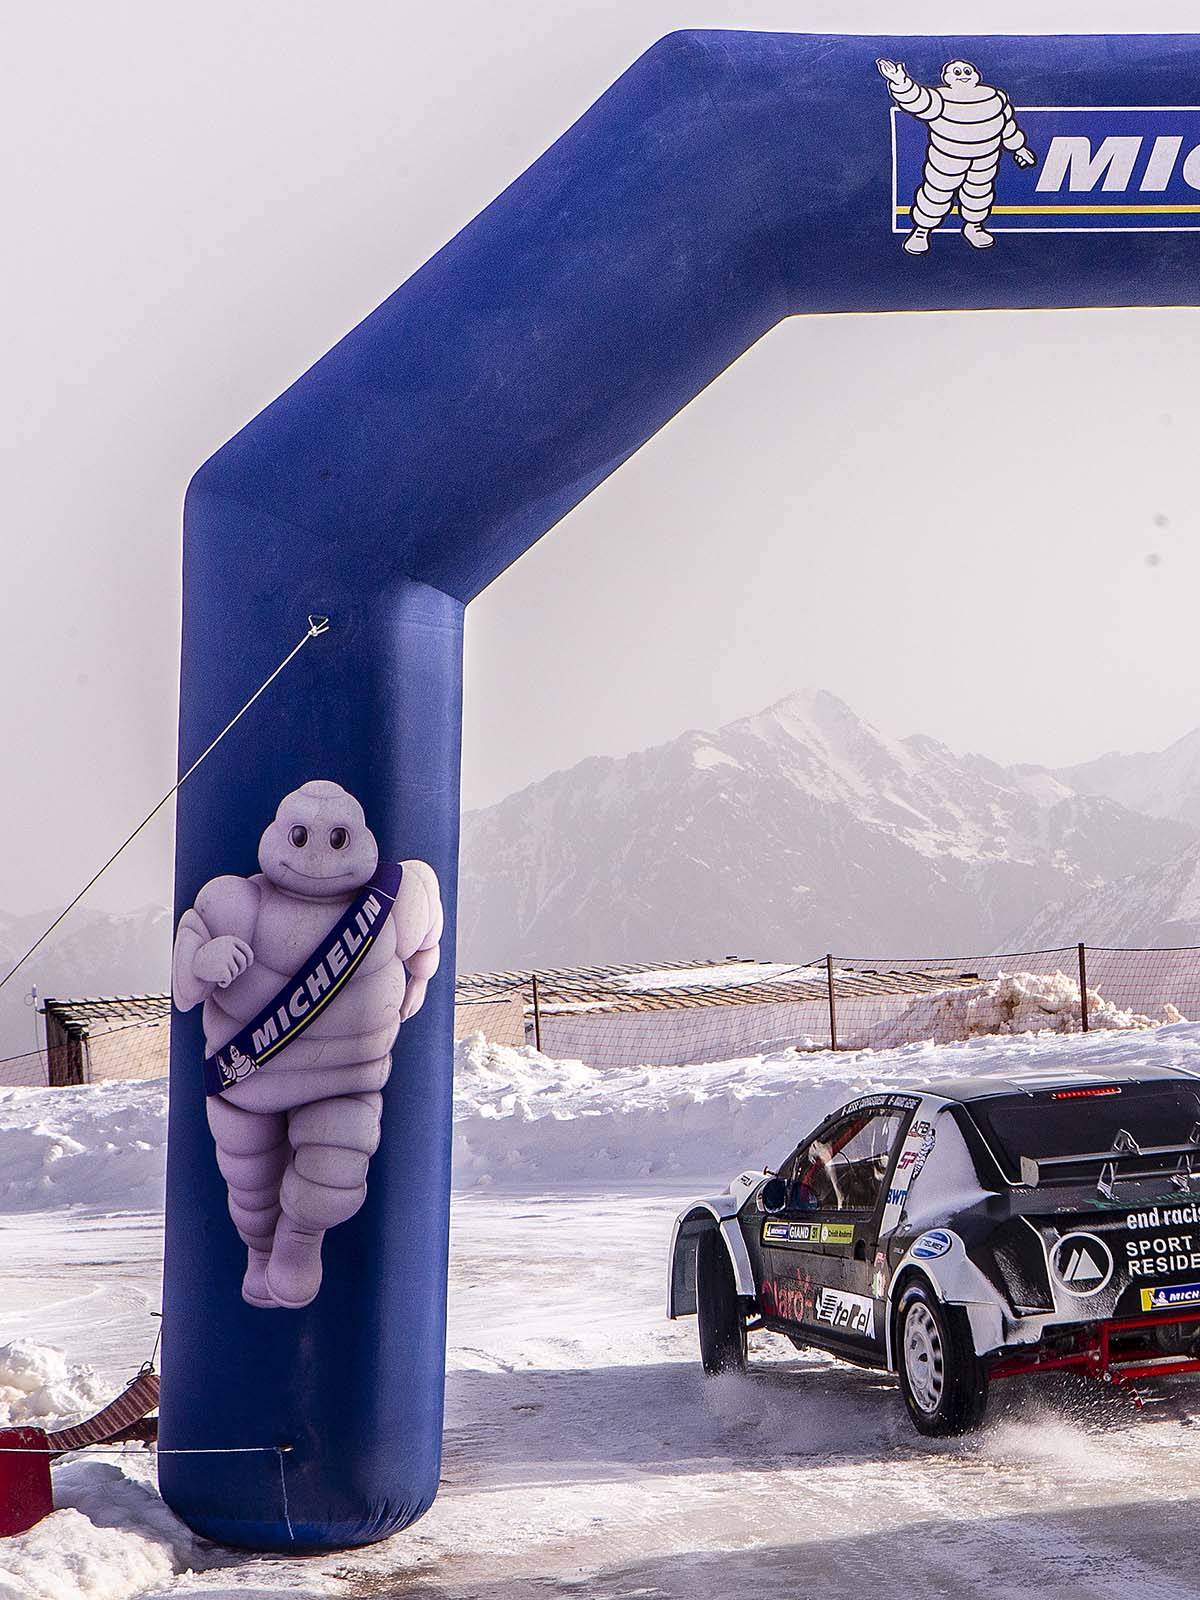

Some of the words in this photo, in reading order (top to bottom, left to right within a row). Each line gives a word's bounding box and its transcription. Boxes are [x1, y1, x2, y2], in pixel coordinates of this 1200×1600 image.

[252, 894, 382, 1053] MICHELIN
[1126, 1207, 1160, 1229] end
[1125, 1235, 1193, 1257] SPORT
